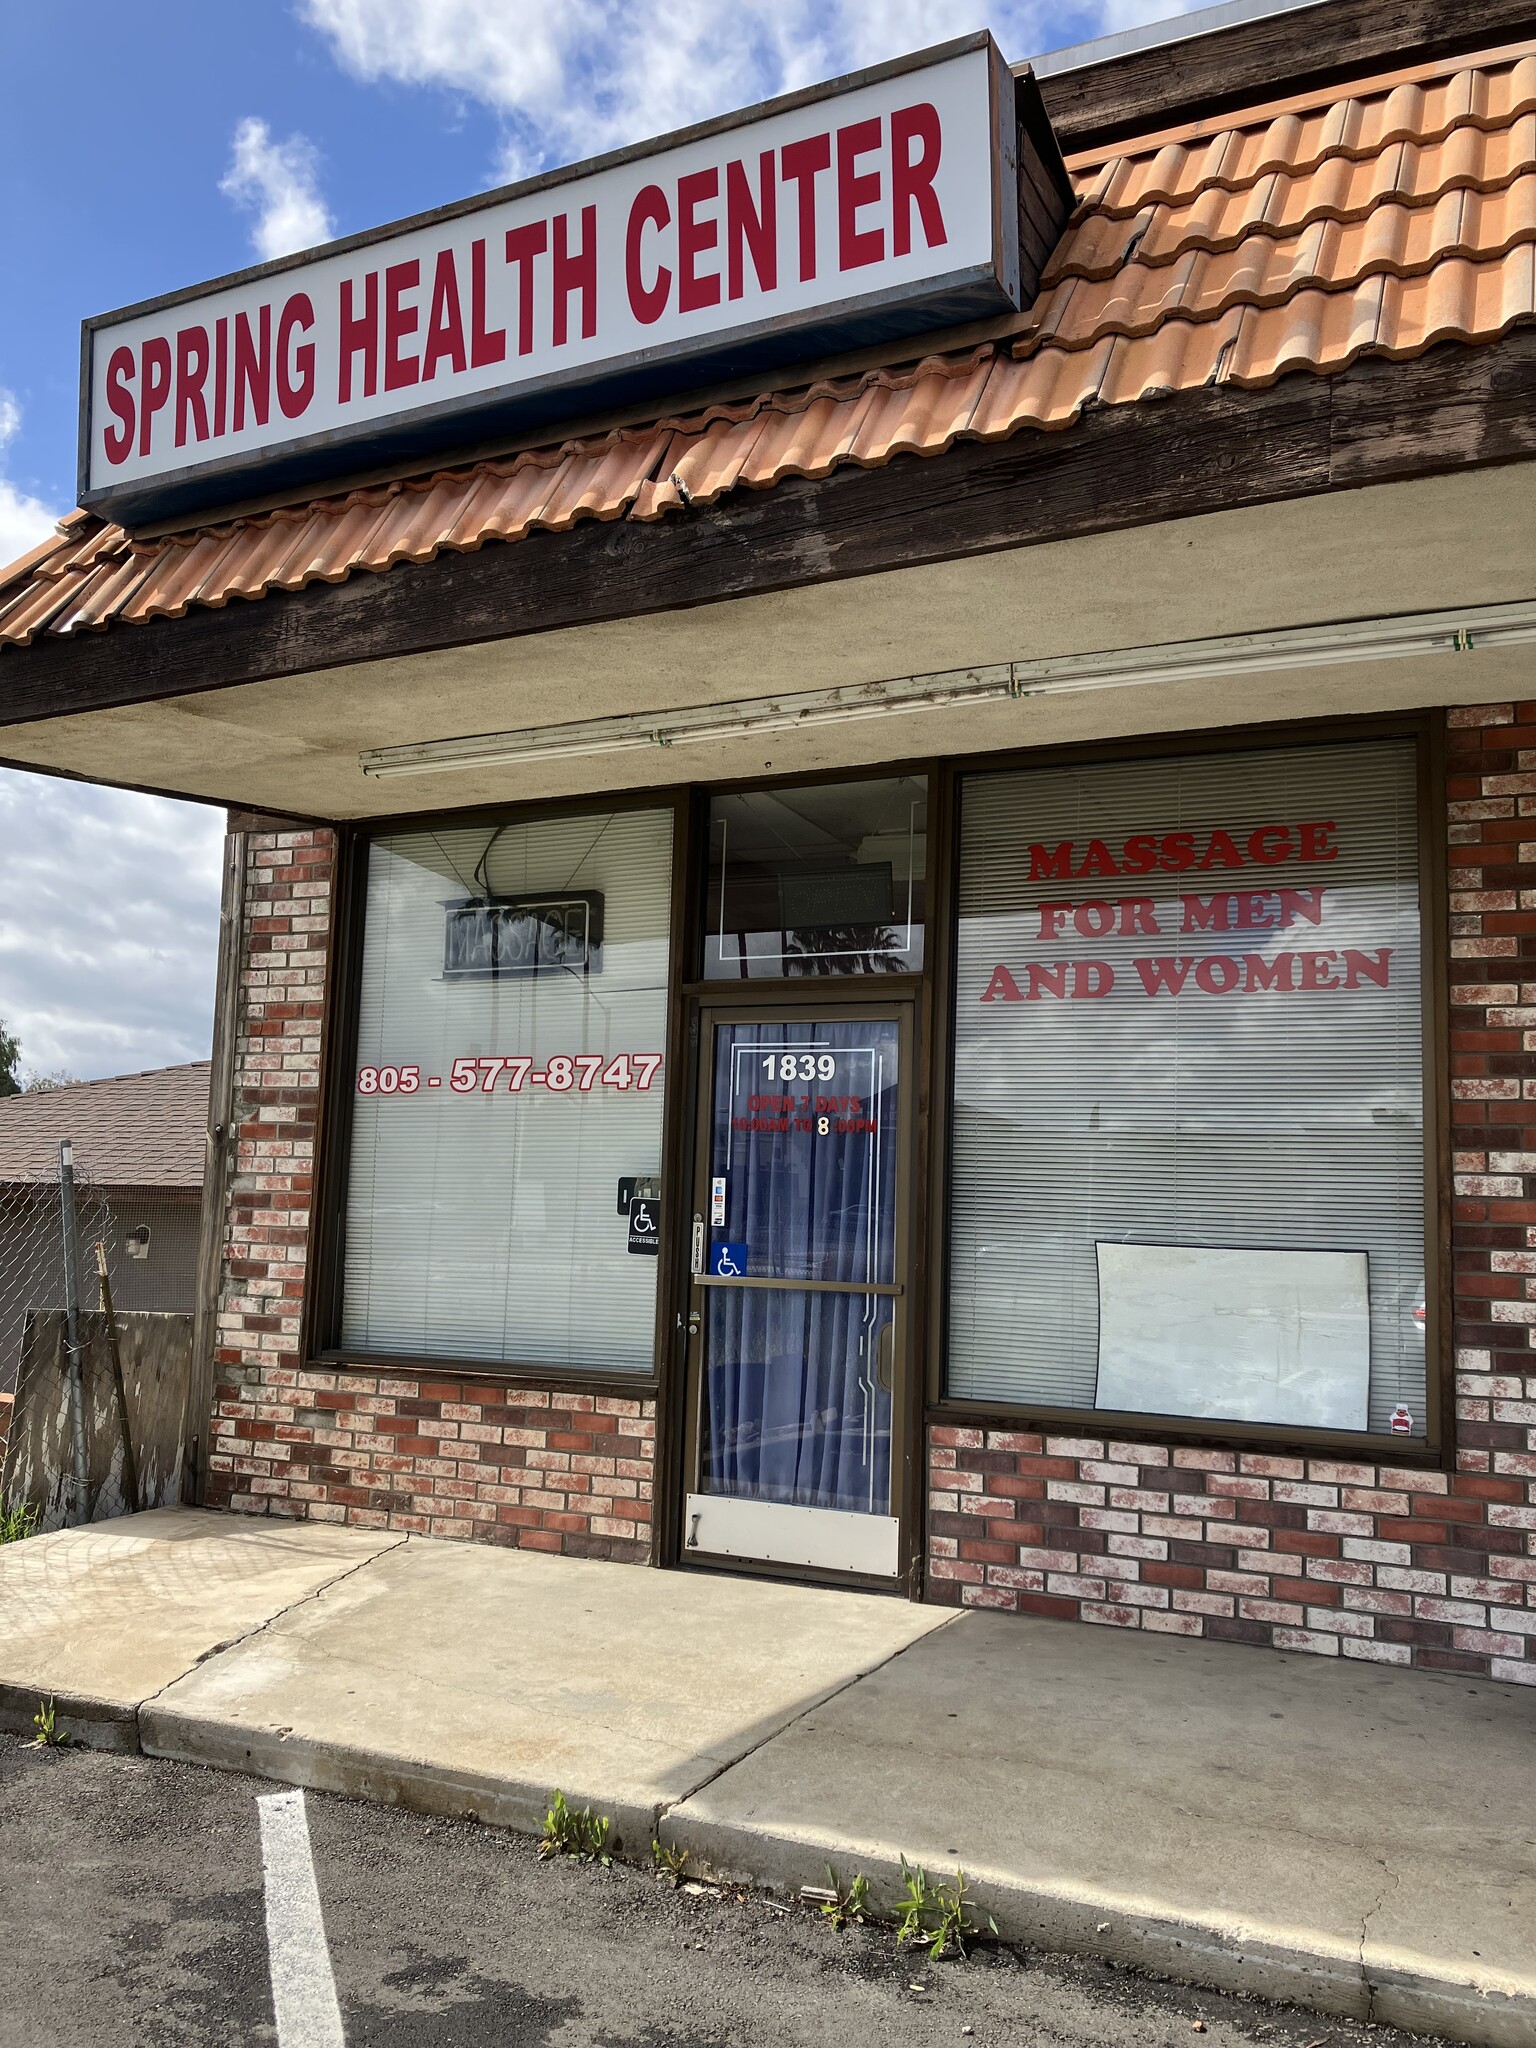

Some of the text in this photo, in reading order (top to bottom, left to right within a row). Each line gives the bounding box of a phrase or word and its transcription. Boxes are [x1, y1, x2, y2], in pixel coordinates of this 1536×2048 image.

[104, 103, 948, 465] SPRING HEALTH CENTER
[1026, 821, 1339, 881] MASSAGE
[1036, 887, 1327, 940] FOR MEN
[980, 948, 1394, 1002] AND WOMEN
[358, 1066, 420, 1095] 805
[450, 1053, 662, 1093] 577-8747
[762, 1054, 836, 1082] 1839
[732, 1117, 790, 1133] 10:00AM
[794, 1117, 813, 1133] TO
[747, 1095, 861, 1113] OPEN 7 DAYS
[629, 1237, 659, 1245] ACCESSIBLE
